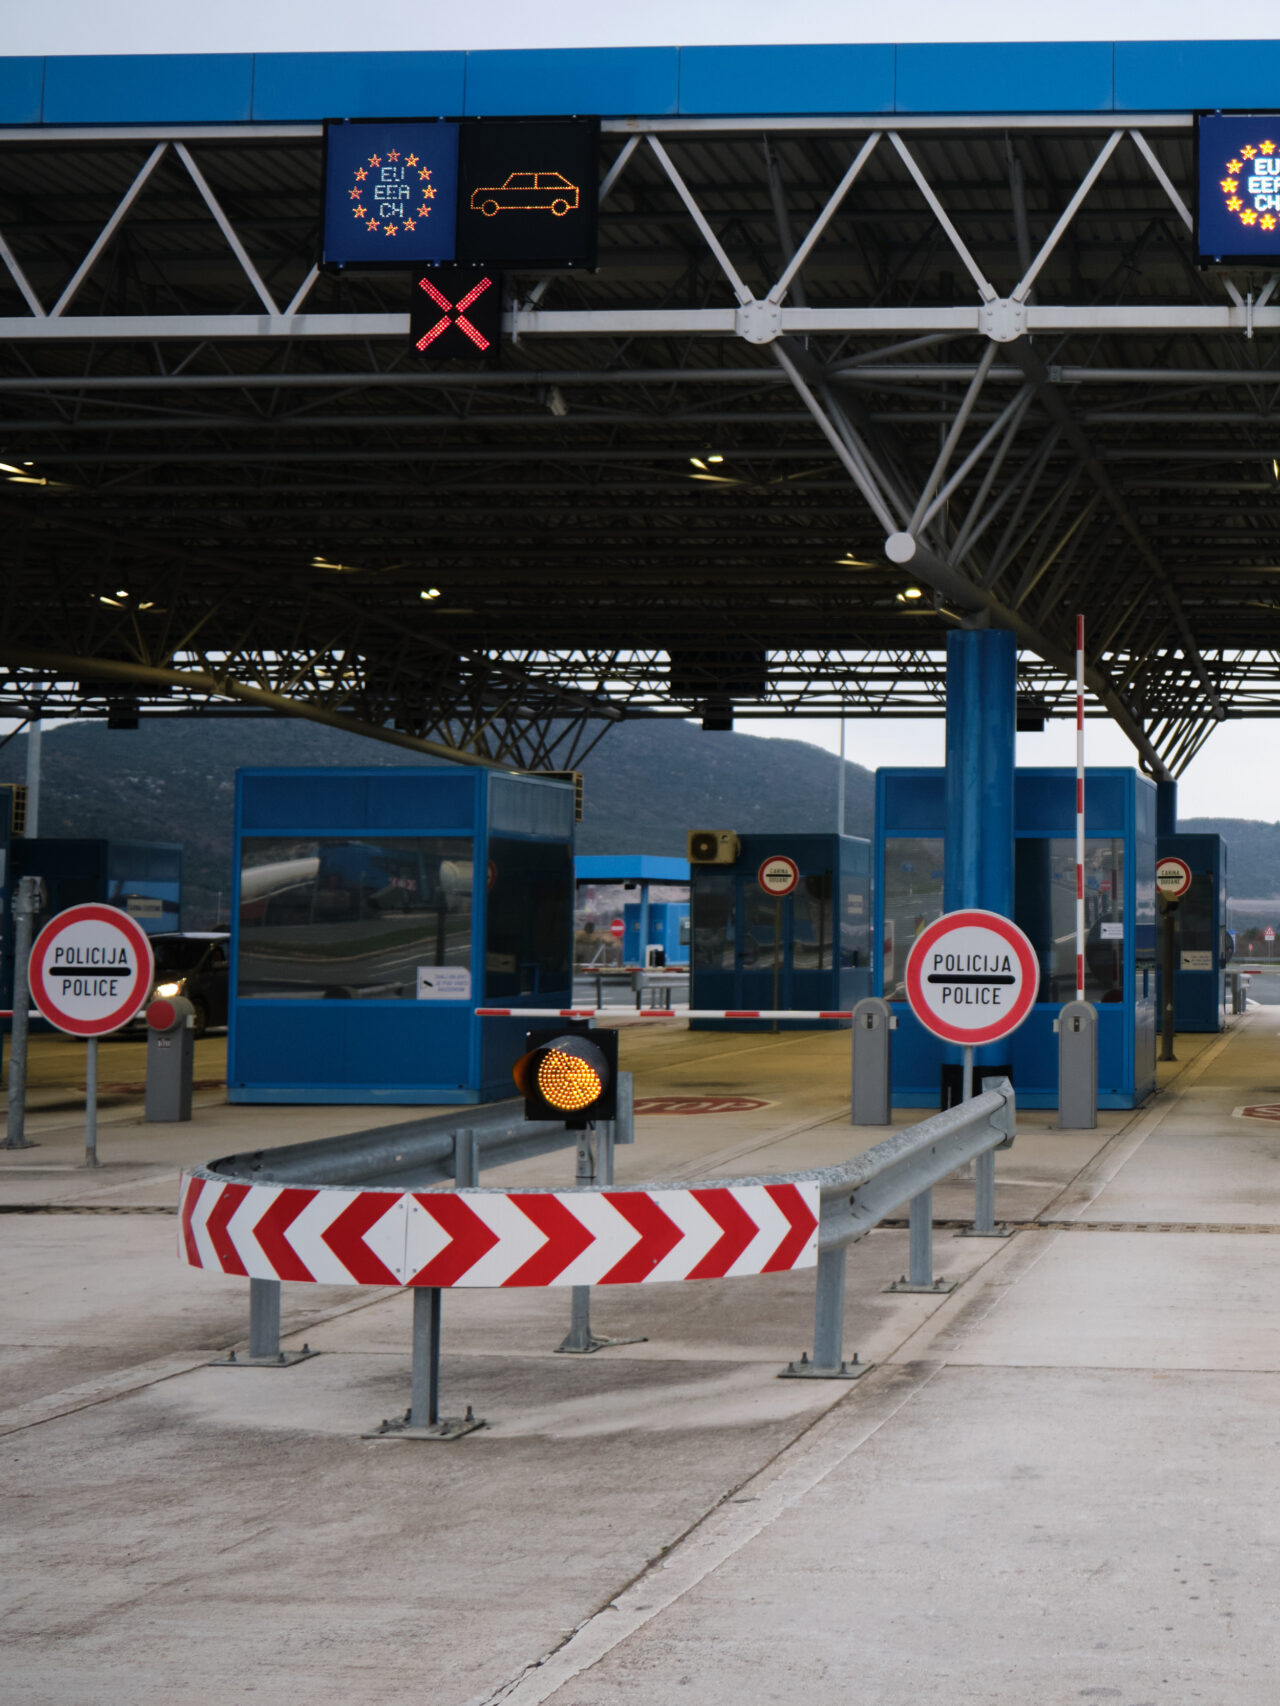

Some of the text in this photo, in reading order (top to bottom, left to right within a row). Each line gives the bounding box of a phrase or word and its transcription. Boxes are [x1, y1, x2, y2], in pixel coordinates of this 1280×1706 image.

[381, 167, 405, 182] EU
[1254, 158, 1280, 175] EU
[374, 185, 410, 200] EEA
[380, 202, 404, 218] CH
[1254, 194, 1280, 211] CH
[55, 947, 128, 965] POLICIJA
[934, 954, 1012, 972] POLICIJA
[62, 979, 118, 996] POLICE
[942, 987, 1002, 1005] POLICE
